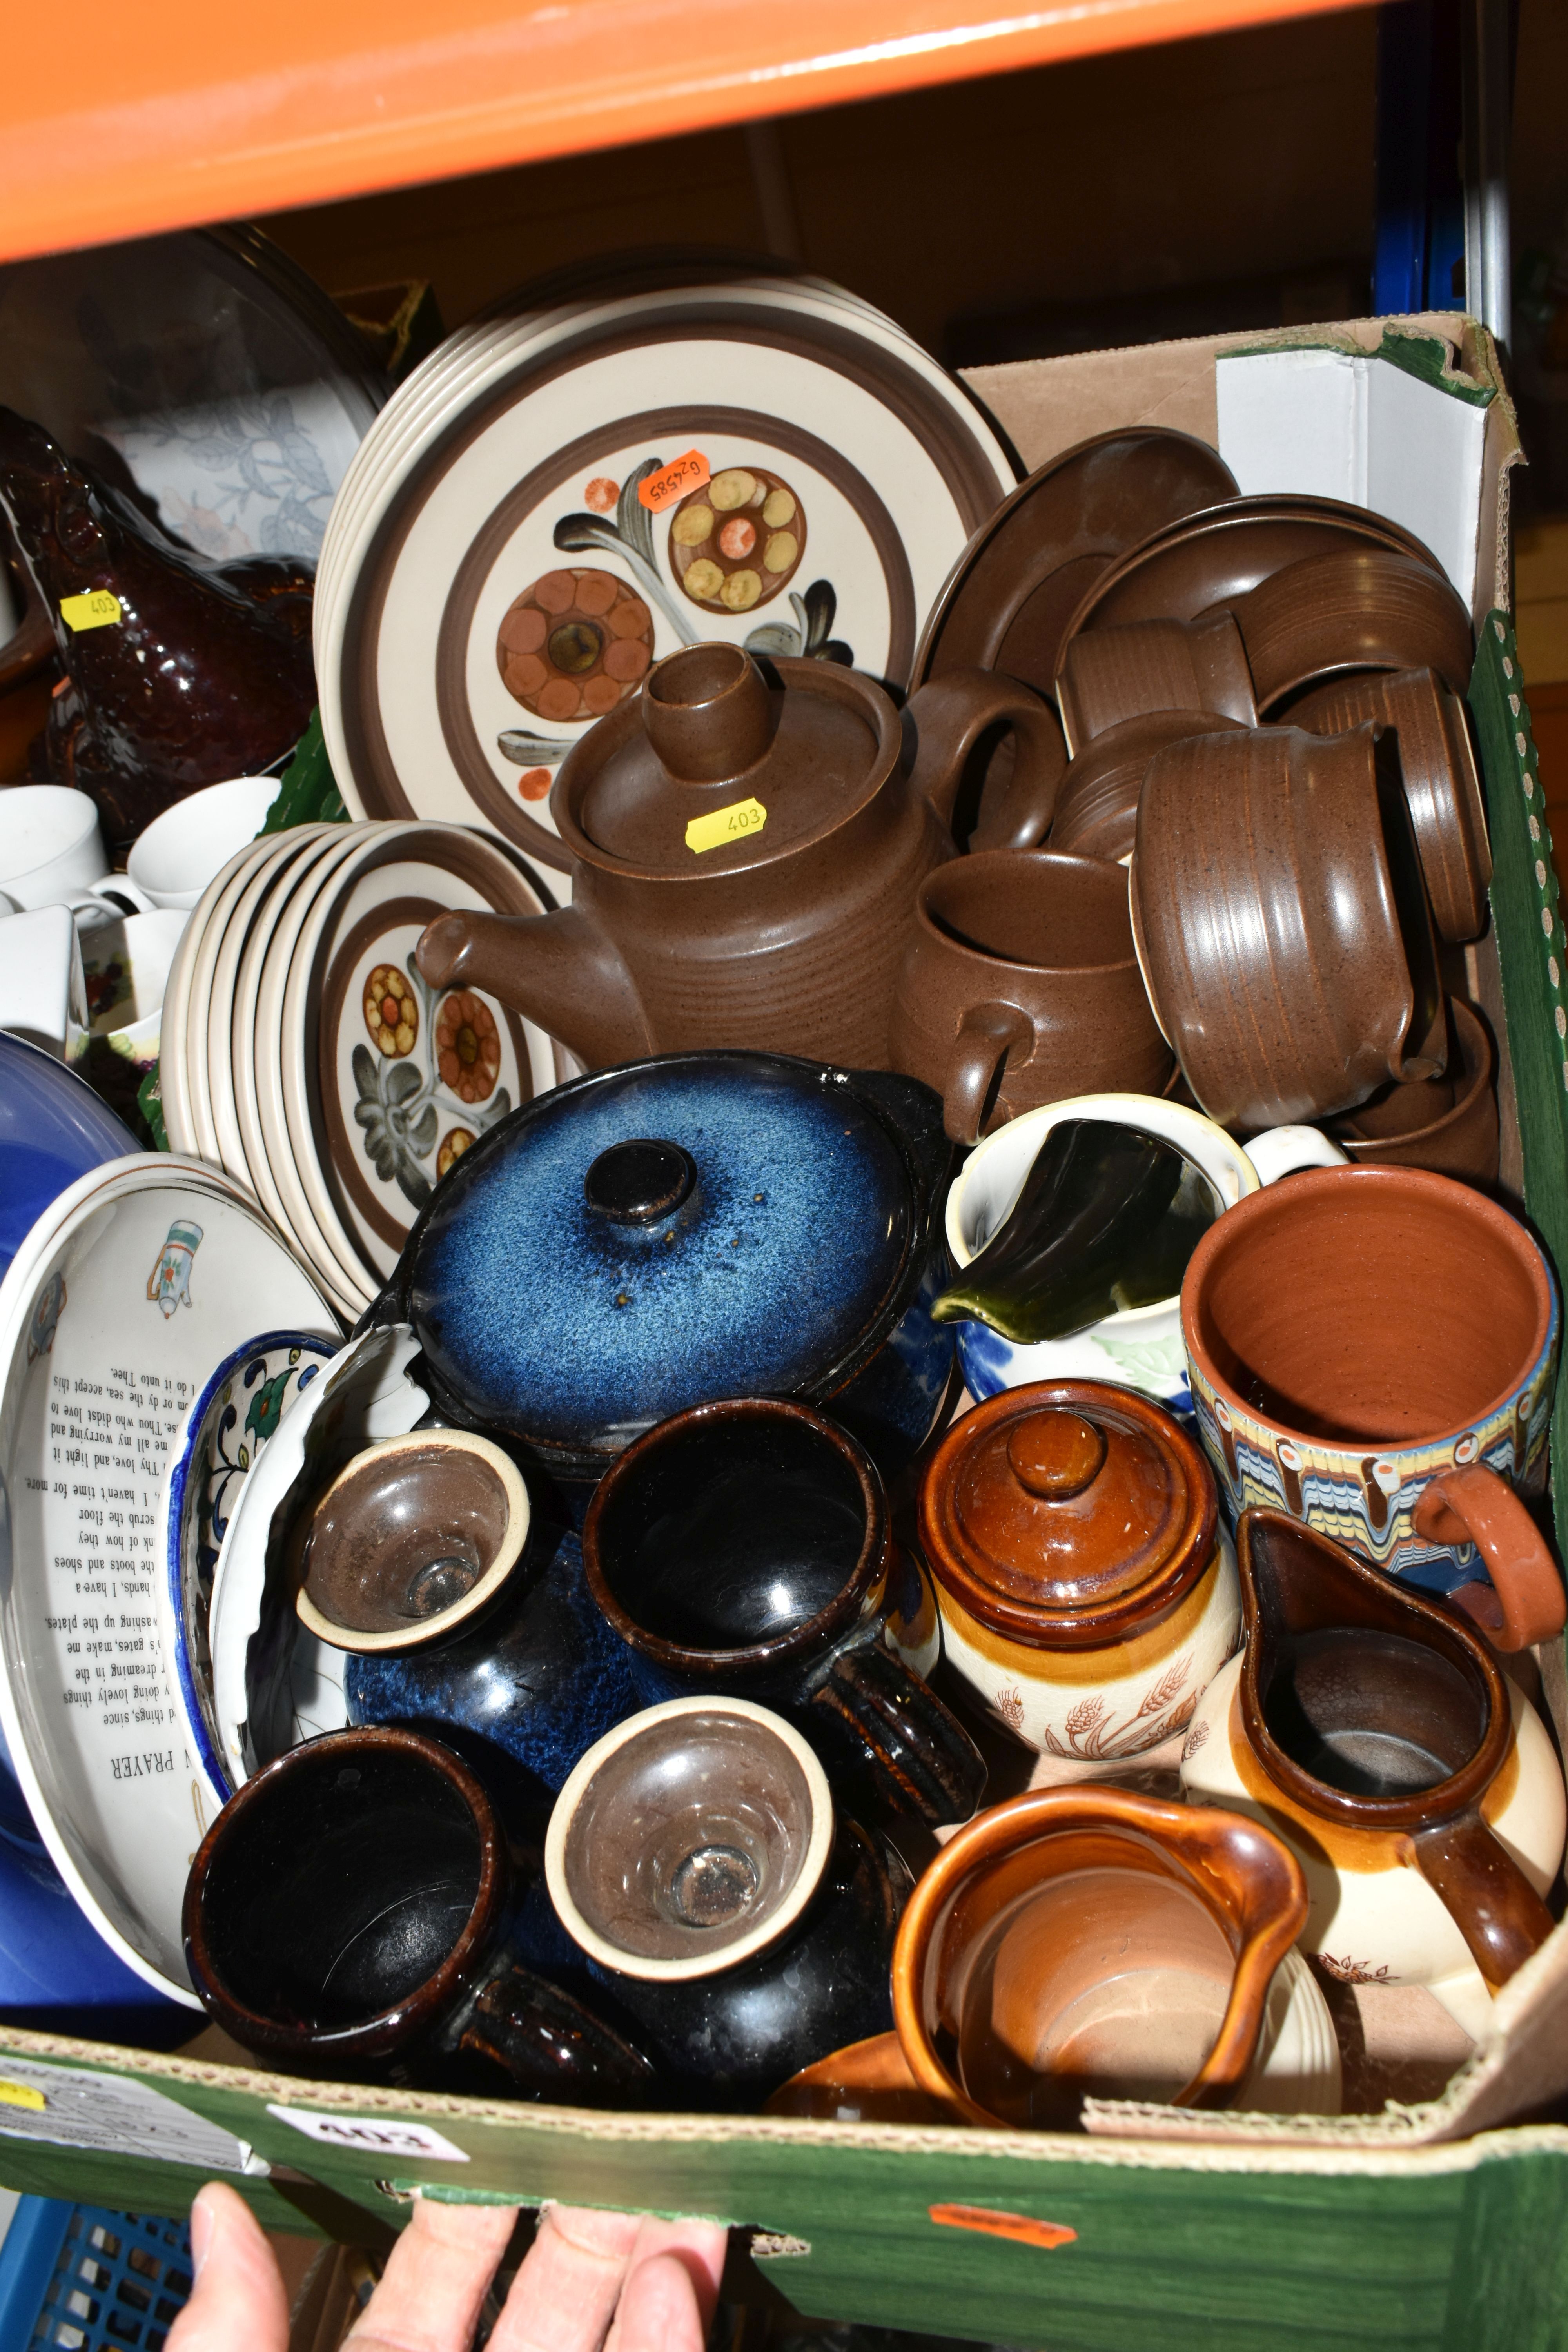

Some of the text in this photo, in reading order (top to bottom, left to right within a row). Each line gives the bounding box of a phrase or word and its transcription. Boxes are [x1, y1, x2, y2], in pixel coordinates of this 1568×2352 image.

[91, 597, 115, 614] 403
[728, 809, 760, 831] 403
[54, 1376, 69, 1394] this
[111, 1368, 136, 1387] Thee.
[141, 1375, 160, 1387] unto
[74, 1379, 102, 1396] accept
[106, 1387, 124, 1401] sea,
[165, 1380, 172, 1393] it
[177, 1382, 187, 1396] do
[130, 1392, 143, 1407] the
[149, 1394, 158, 1411] dy
[163, 1399, 172, 1409] or
[51, 1403, 58, 1415] to
[64, 1405, 82, 1423] love
[88, 1410, 111, 1427] didst
[116, 1416, 134, 1430] who
[139, 1419, 162, 1436] Thou
[51, 1423, 167, 1453] me all my worrying and
[54, 1448, 159, 1476] Thy love, and light it
[25, 1478, 48, 1491] more.
[54, 1483, 67, 1499] for
[73, 1485, 95, 1500] time
[101, 1488, 135, 1504] haven't
[143, 1493, 148, 1506] I
[79, 1510, 154, 1528] scrub the floor
[79, 1531, 98, 1549] they
[106, 1536, 123, 1551] how
[130, 1537, 138, 1551] of
[55, 1557, 154, 1575] the boots and shoes
[76, 1583, 81, 1593] a
[113, 1583, 116, 1597] I
[121, 1581, 150, 1597] hands,
[45, 1614, 77, 1633] plates.
[83, 1618, 98, 1633] the
[104, 1615, 115, 1626] up
[67, 1642, 80, 1654] me
[87, 1642, 112, 1657] make
[115, 1638, 143, 1653] gates,
[76, 1668, 90, 1684] the
[96, 1667, 105, 1682] in
[111, 1664, 156, 1680] dreaming
[63, 1690, 92, 1707] things
[98, 1688, 128, 1706] lovely
[134, 1685, 159, 1701] doing
[103, 1713, 129, 1727] since
[132, 1708, 163, 1724] things,
[111, 1751, 174, 1779] PRAYER
